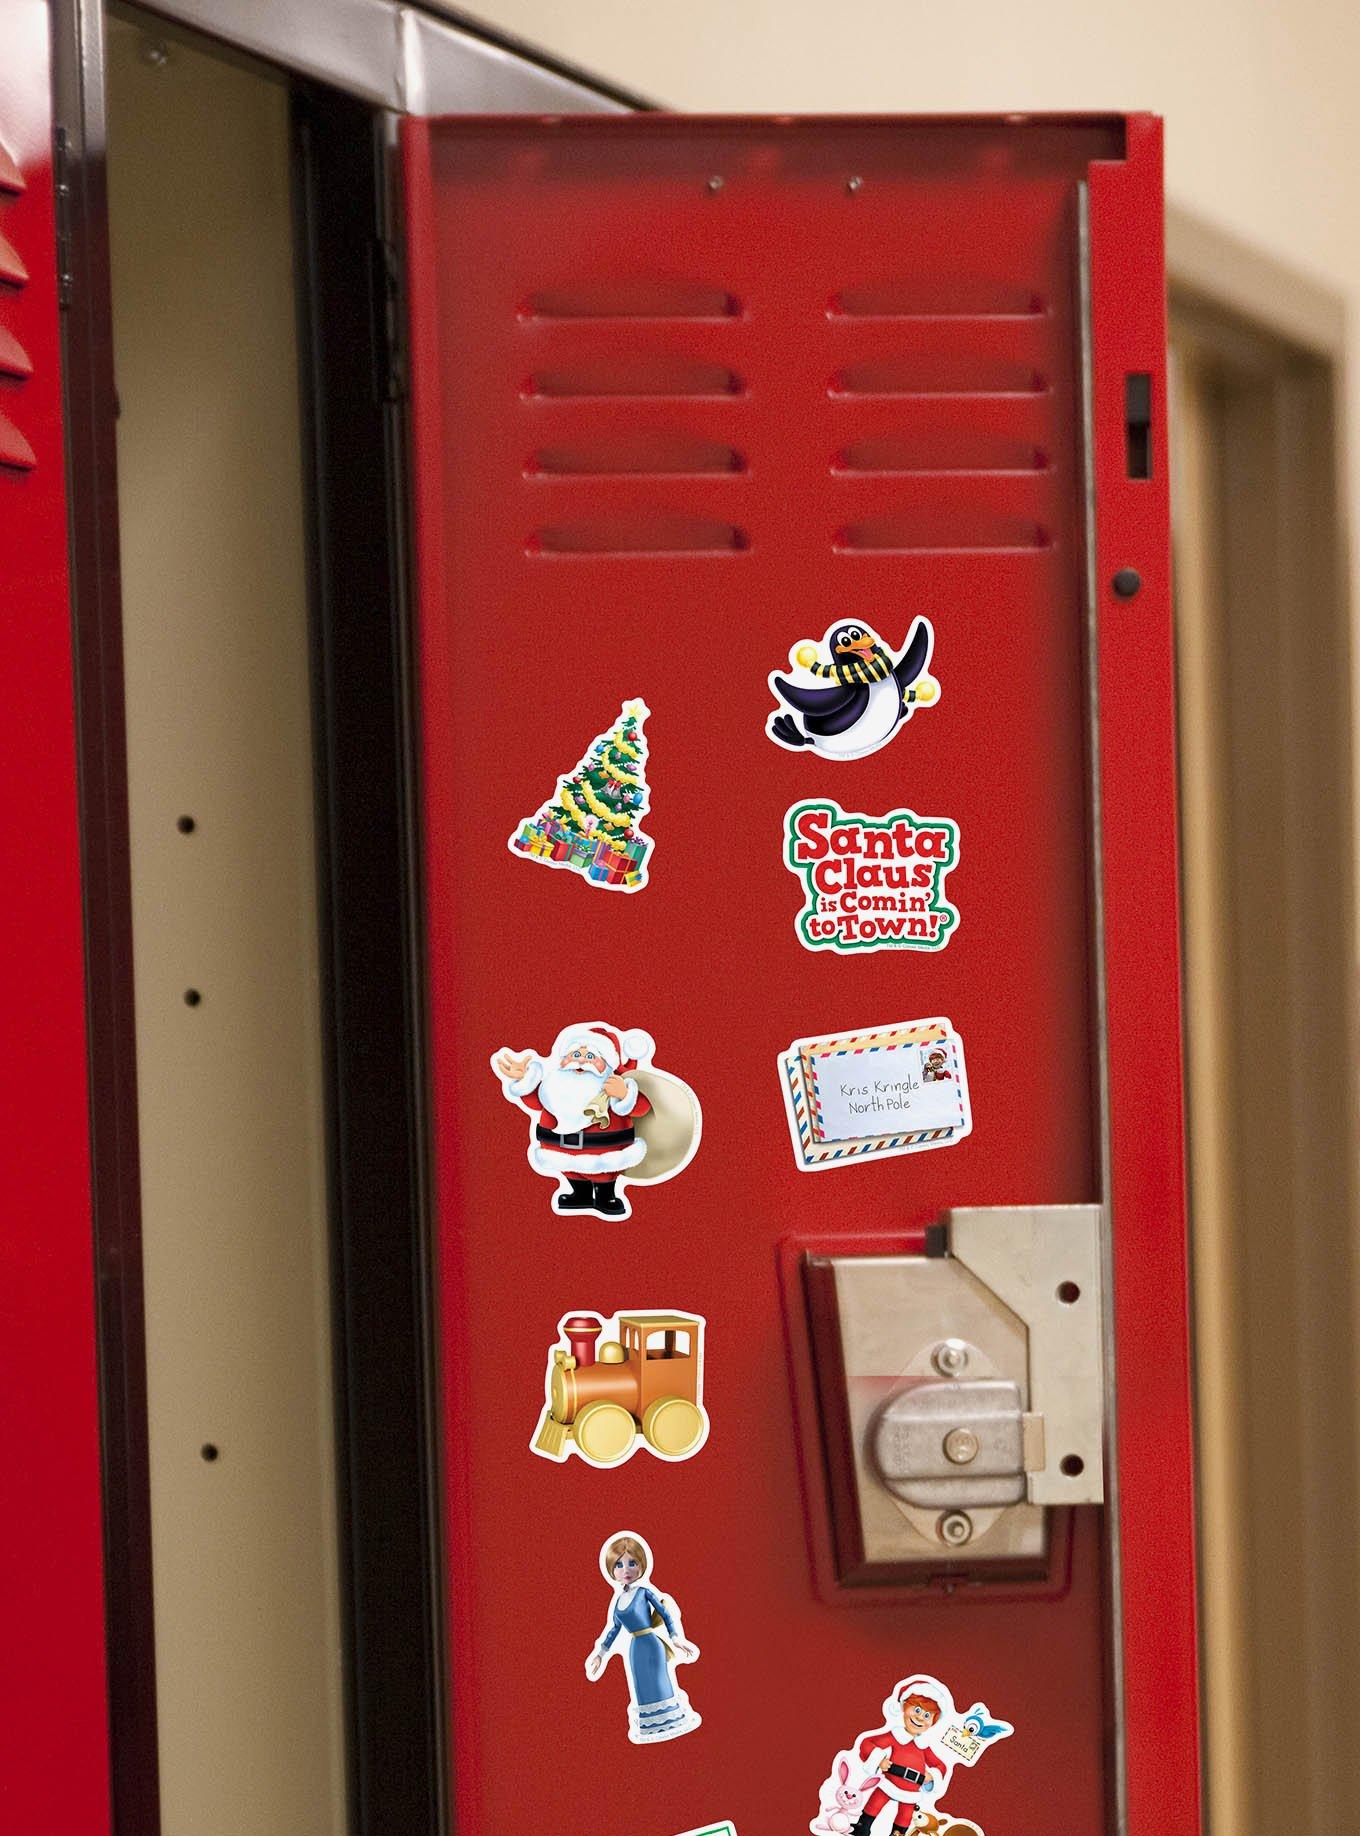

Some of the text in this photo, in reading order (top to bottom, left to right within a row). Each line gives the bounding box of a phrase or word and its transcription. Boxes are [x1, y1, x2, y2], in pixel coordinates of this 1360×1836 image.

[798, 813, 945, 859] Santa
[816, 858, 932, 894] Claus
[821, 892, 930, 913] is Comin'
[810, 918, 835, 937] to
[840, 1074, 919, 1096] Kris Kringle
[849, 1093, 911, 1114] North Pole
[949, 1736, 968, 1753] Santa
